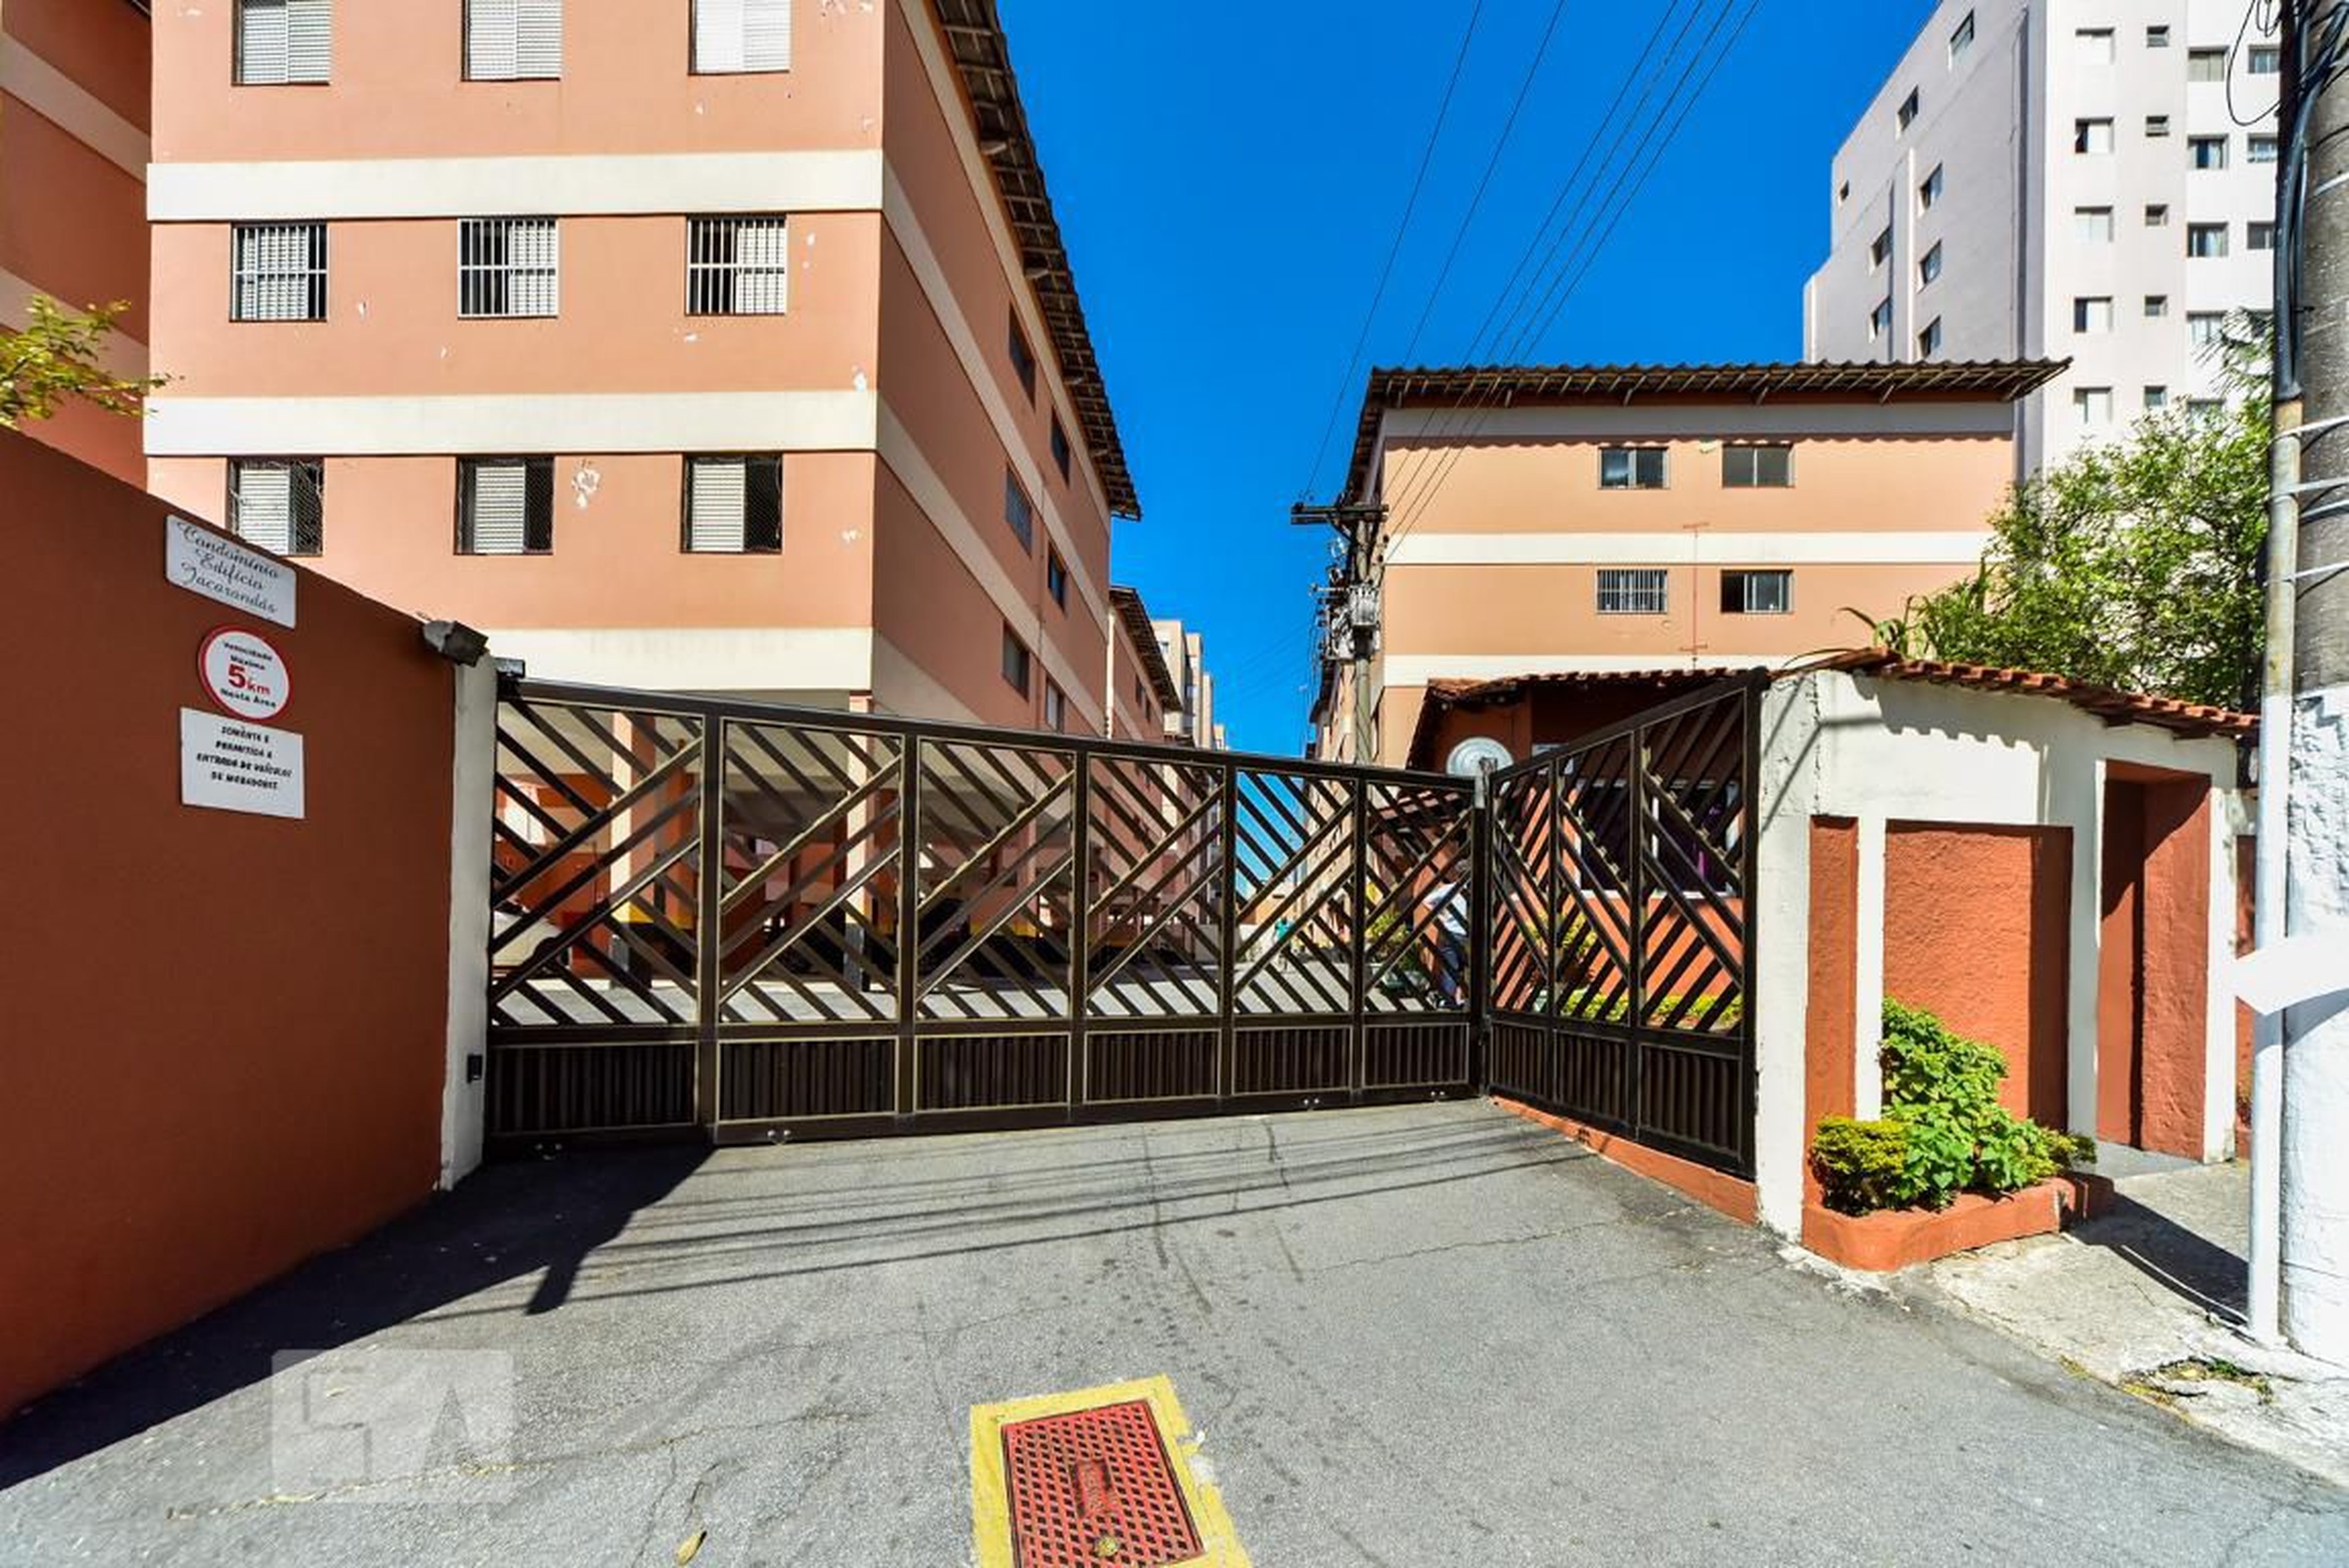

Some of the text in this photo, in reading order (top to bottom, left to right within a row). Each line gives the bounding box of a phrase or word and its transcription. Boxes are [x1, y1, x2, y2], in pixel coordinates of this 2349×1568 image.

[196, 753, 238, 767] ENTRADA
[240, 760, 251, 771] DE
[212, 771, 223, 781] DE
